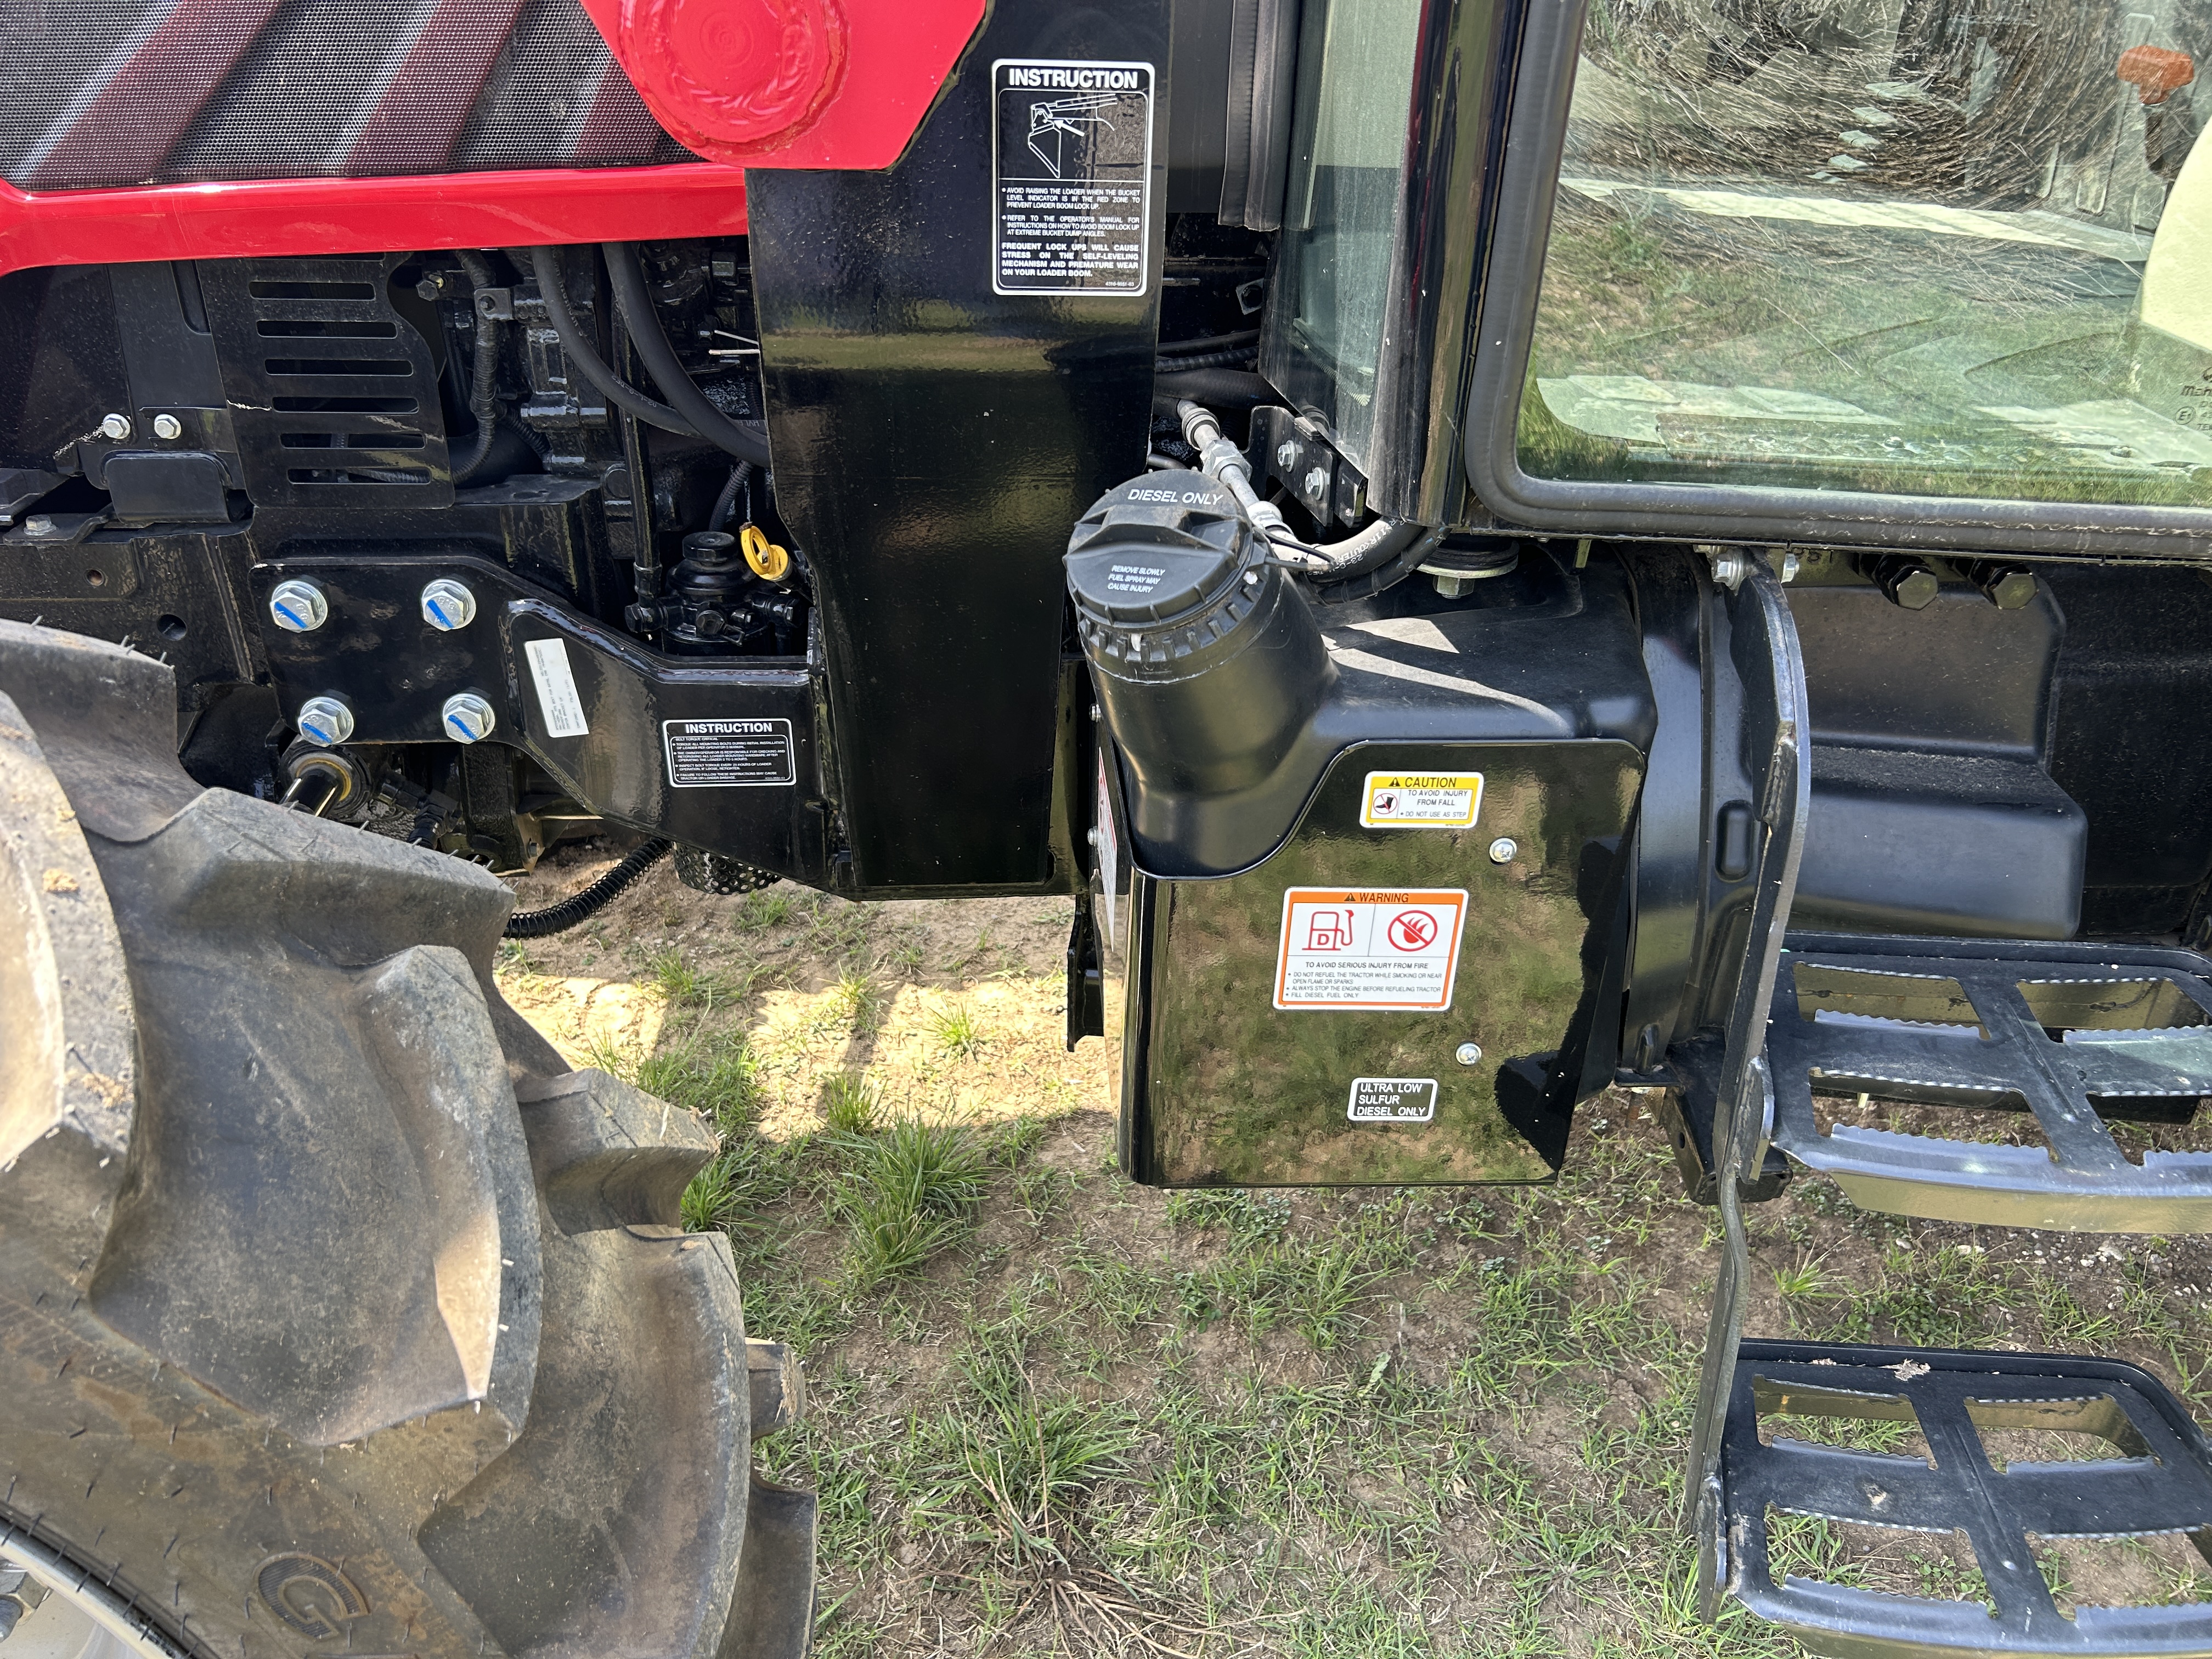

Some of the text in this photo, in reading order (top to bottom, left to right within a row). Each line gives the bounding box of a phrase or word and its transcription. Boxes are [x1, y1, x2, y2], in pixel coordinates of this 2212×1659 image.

[1009, 68, 1138, 89] INSTRUCTION
[1127, 488, 1224, 506] DIESEL ONLY
[1111, 565, 1165, 576] REMOVE SLOWLY
[1108, 573, 1124, 582] FUEL
[1125, 575, 1147, 583] SPRAY
[1108, 582, 1153, 593] CAUSE INJURY
[685, 723, 772, 733] INSTRUCTION
[1405, 777, 1457, 788] CAUTION
[1359, 893, 1409, 902] WARNING
[1317, 934, 1329, 945] D
[1360, 1083, 1423, 1093] ULTRA LOW
[1358, 1094, 1400, 1104] SULFUR
[1357, 1106, 1426, 1116] DIESEL ONLY
